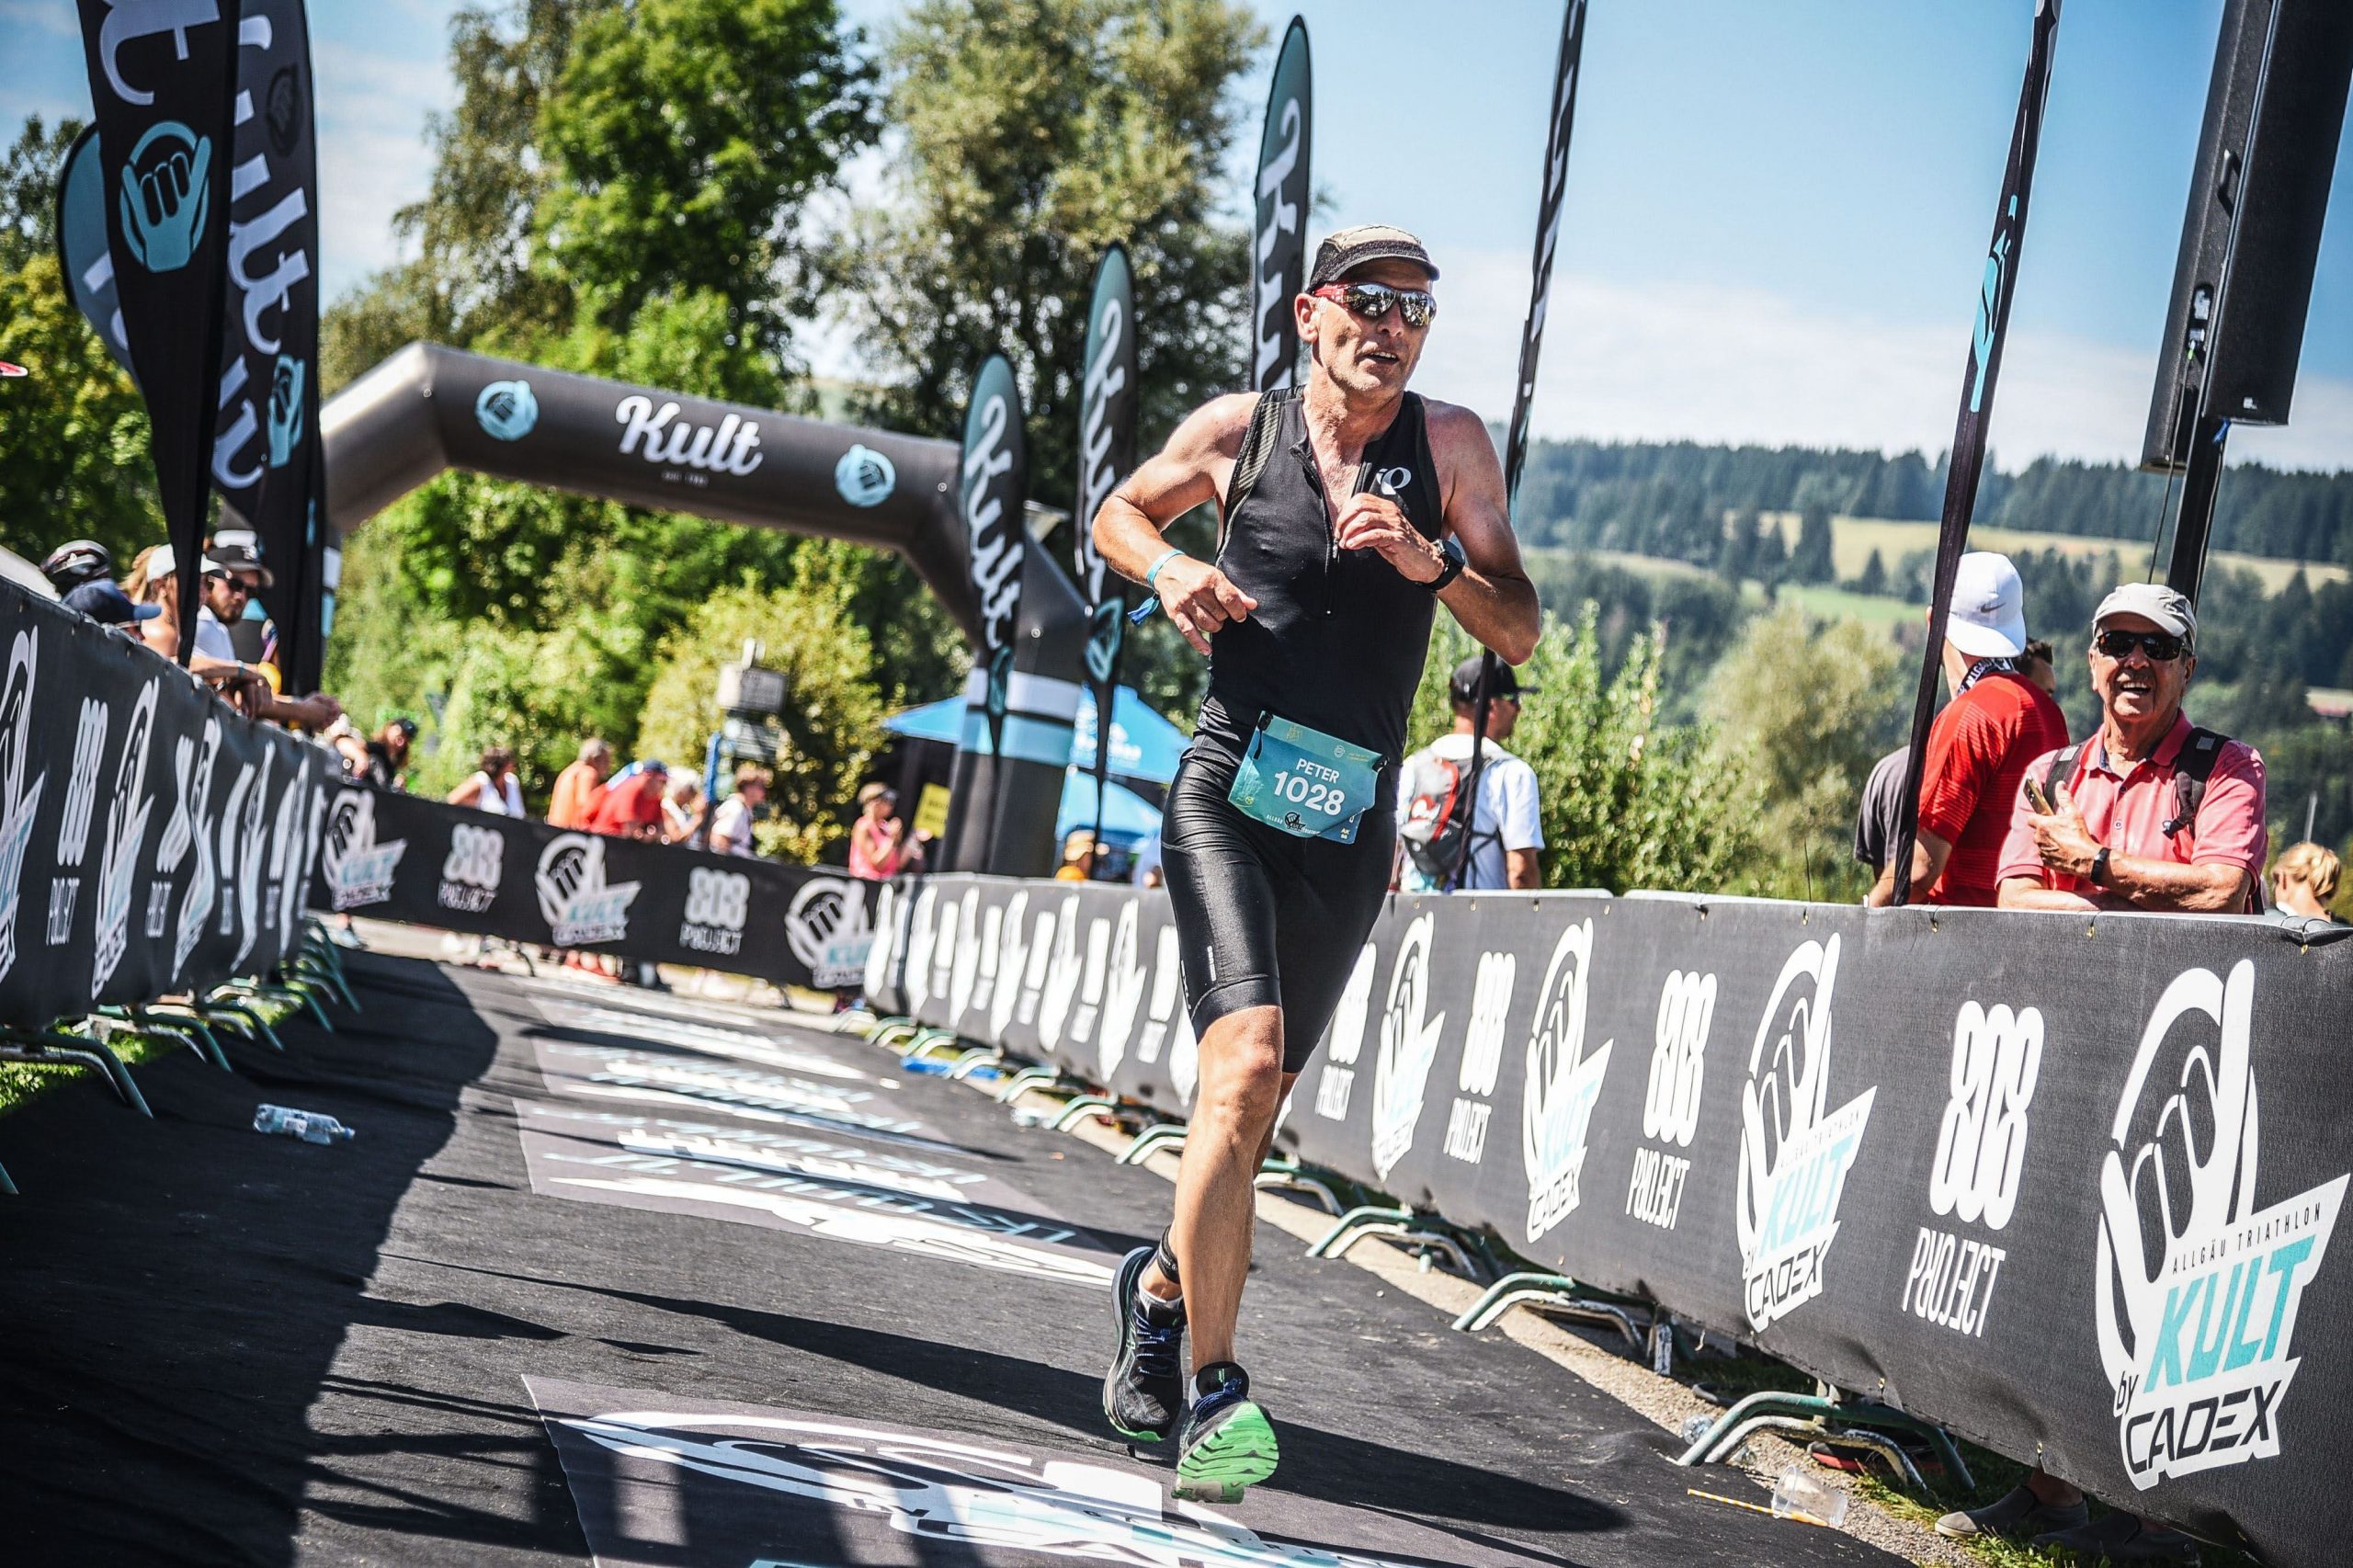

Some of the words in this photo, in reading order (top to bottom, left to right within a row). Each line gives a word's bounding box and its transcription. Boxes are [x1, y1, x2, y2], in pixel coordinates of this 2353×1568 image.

[1258, 97, 1302, 394] Ku
[615, 395, 764, 476] Kult
[965, 394, 1024, 650] Kult
[1274, 770, 1346, 816] 1028
[1295, 757, 1340, 784] PETER
[1643, 969, 1718, 1147] 808
[1929, 1000, 2044, 1231] 808
[1758, 1132, 1855, 1258] KULT
[2172, 1239, 2227, 1275] ALLGÄU
[2237, 1201, 2322, 1252] TRIATHLON
[1749, 1240, 1827, 1321] CADEX
[1902, 1227, 2006, 1338] PROJECT
[2143, 1233, 2317, 1394] KULT
[2116, 1369, 2140, 1416] by
[2125, 1379, 2283, 1476] CADEX
